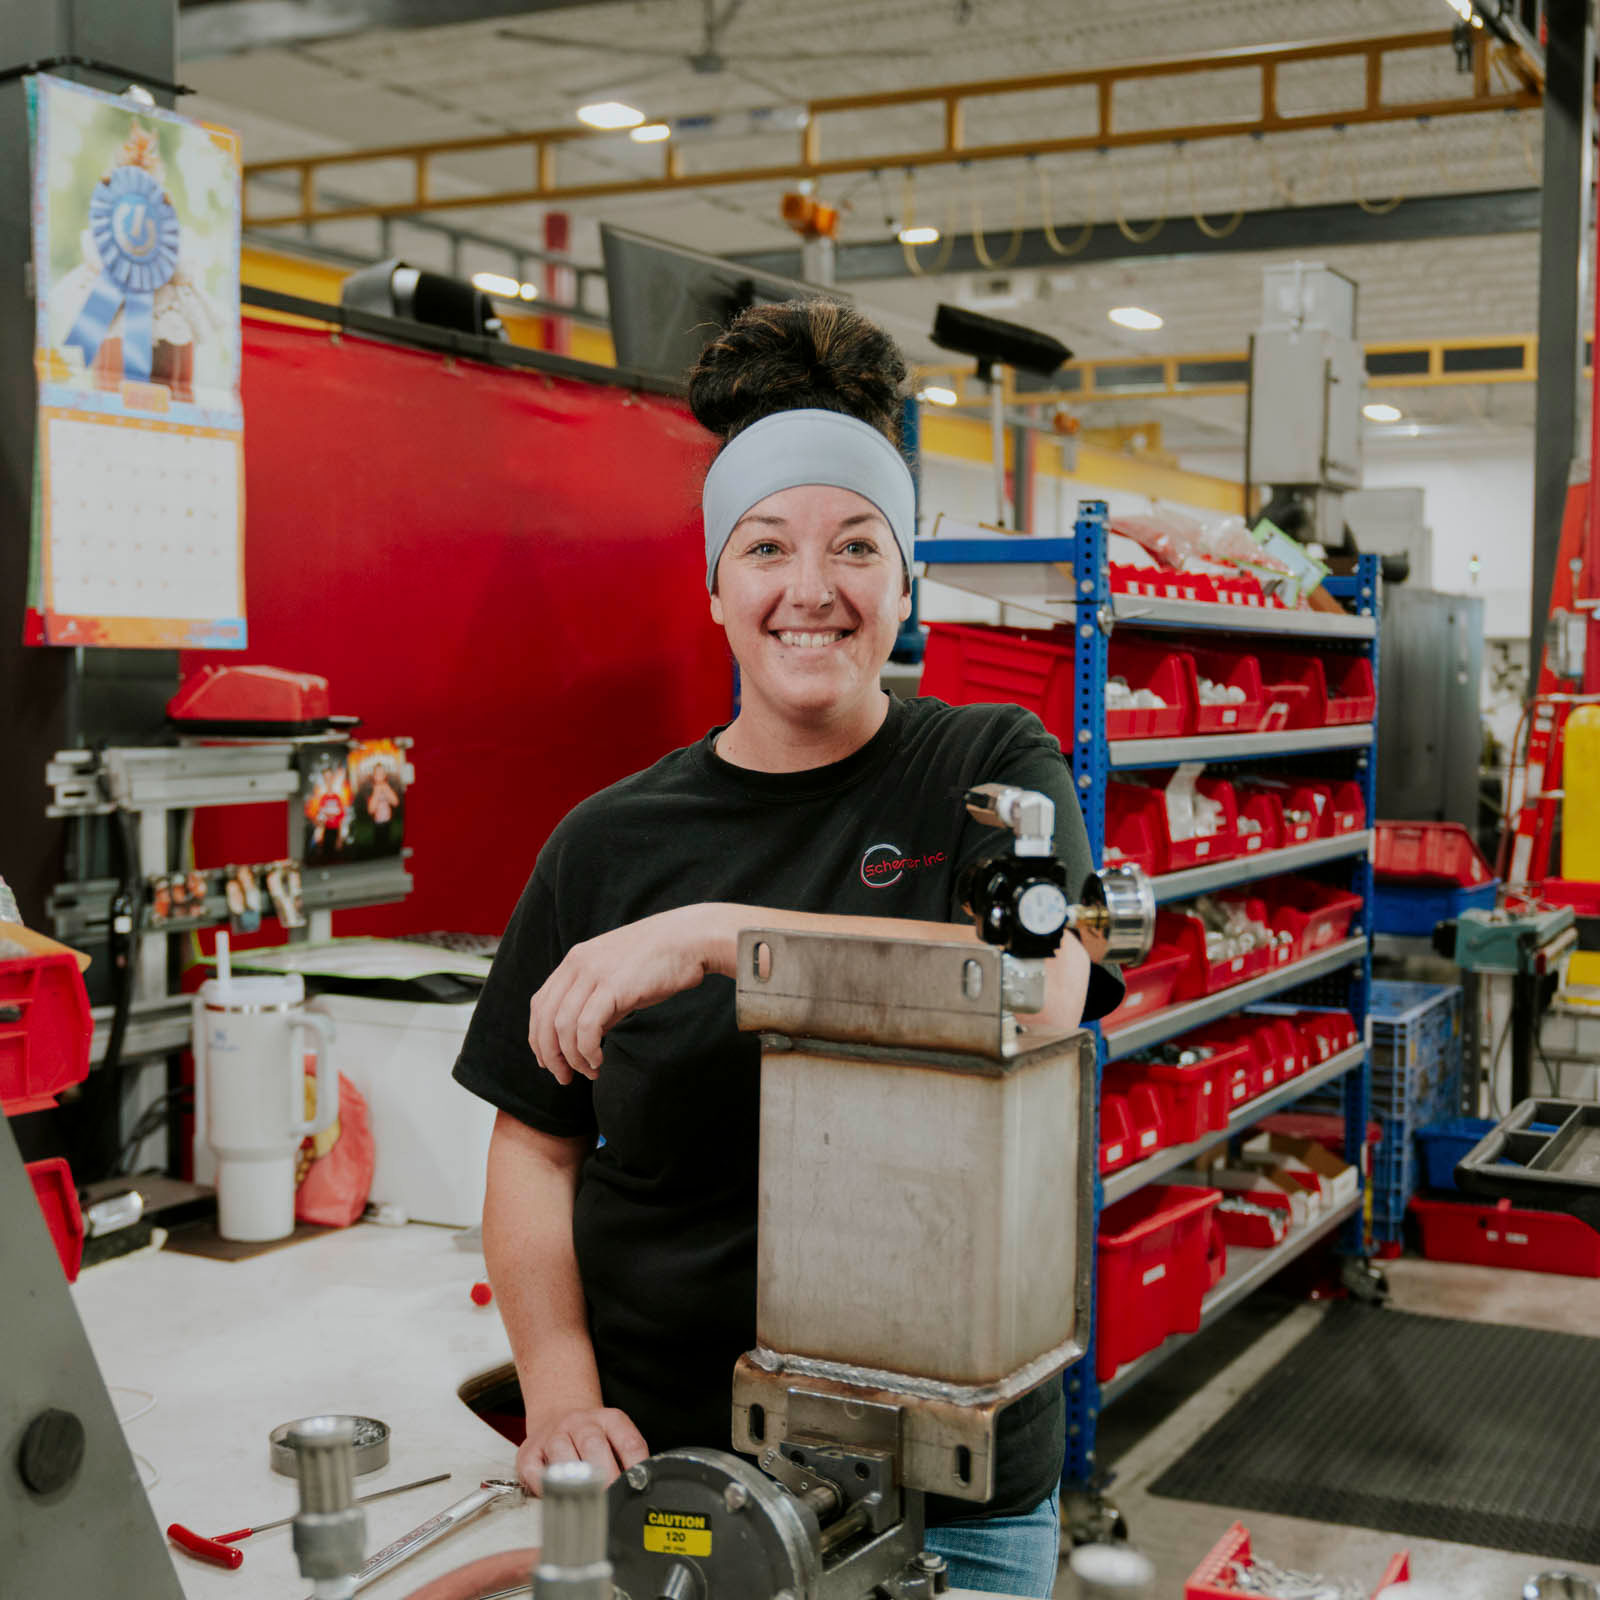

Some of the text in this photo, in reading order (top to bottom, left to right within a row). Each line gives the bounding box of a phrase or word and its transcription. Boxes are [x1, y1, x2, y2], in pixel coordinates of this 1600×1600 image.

[864, 858, 921, 878] Scherer
[648, 1512, 705, 1529] CAUTION
[666, 1531, 686, 1543] 120
